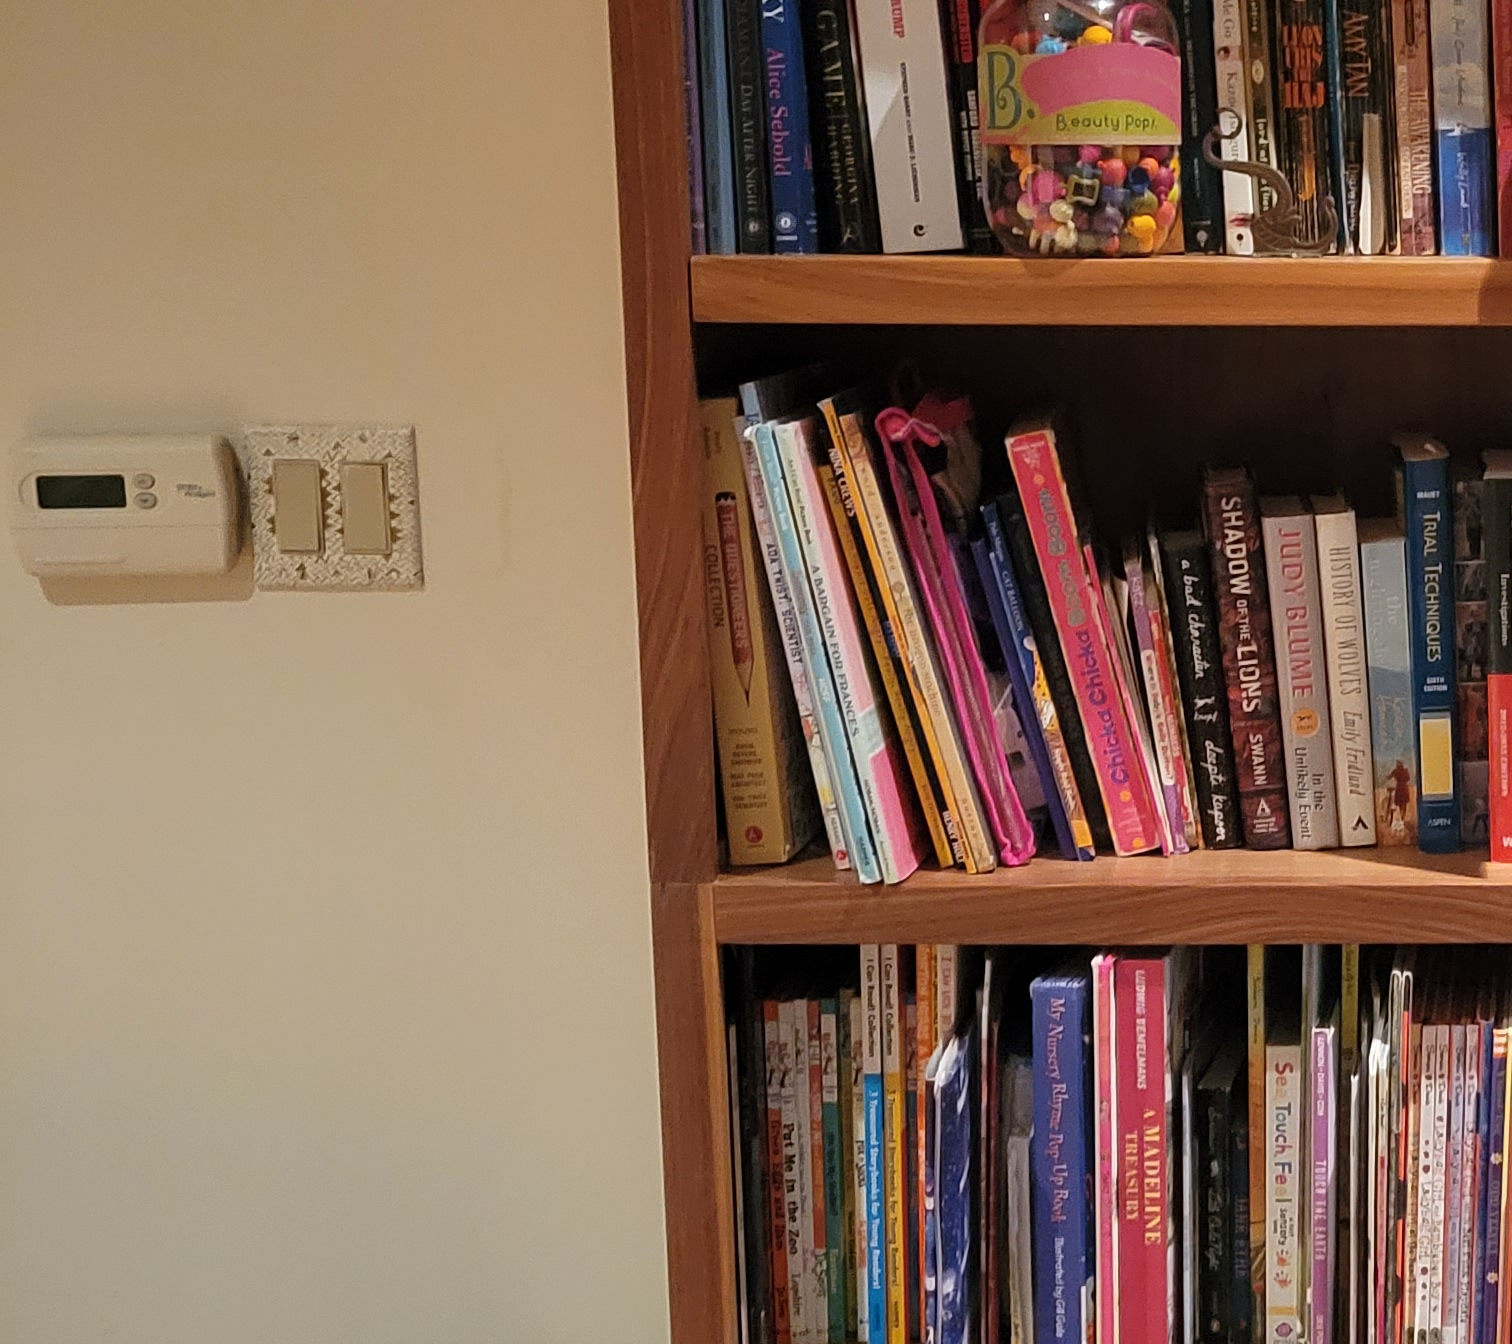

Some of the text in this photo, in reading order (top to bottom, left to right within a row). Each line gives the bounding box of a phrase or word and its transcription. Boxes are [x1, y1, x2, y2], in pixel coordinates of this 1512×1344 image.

[1222, 18, 1235, 39] Go
[766, 48, 792, 177] Alice Sebold
[827, 448, 856, 518] NINA CREWS
[1180, 559, 1207, 679] a bad character
[1219, 496, 1262, 713] SHADOW OF THE LIONS
[1277, 528, 1314, 699] JUDY BLUME
[1328, 547, 1362, 696] HISTORY OF WOLVES
[1421, 511, 1443, 663] TRIAL TECHNIQUES
[810, 565, 860, 737] A BARGAIN FOR FRANCES
[1248, 733, 1268, 786] SWANN
[1294, 746, 1313, 840] Unlikely Event
[1311, 773, 1326, 811] In the
[1340, 710, 1368, 796] Emily Fridlund
[1135, 970, 1147, 1090] LUDWIG BEMELMANS
[1046, 997, 1069, 1224] My Nursery Rhyme Pop-Up Book
[781, 1123, 800, 1255] Put Me in the Zoo
[1125, 1131, 1139, 1221] TREASURY
[1143, 1108, 1161, 1246] A MADELINE
